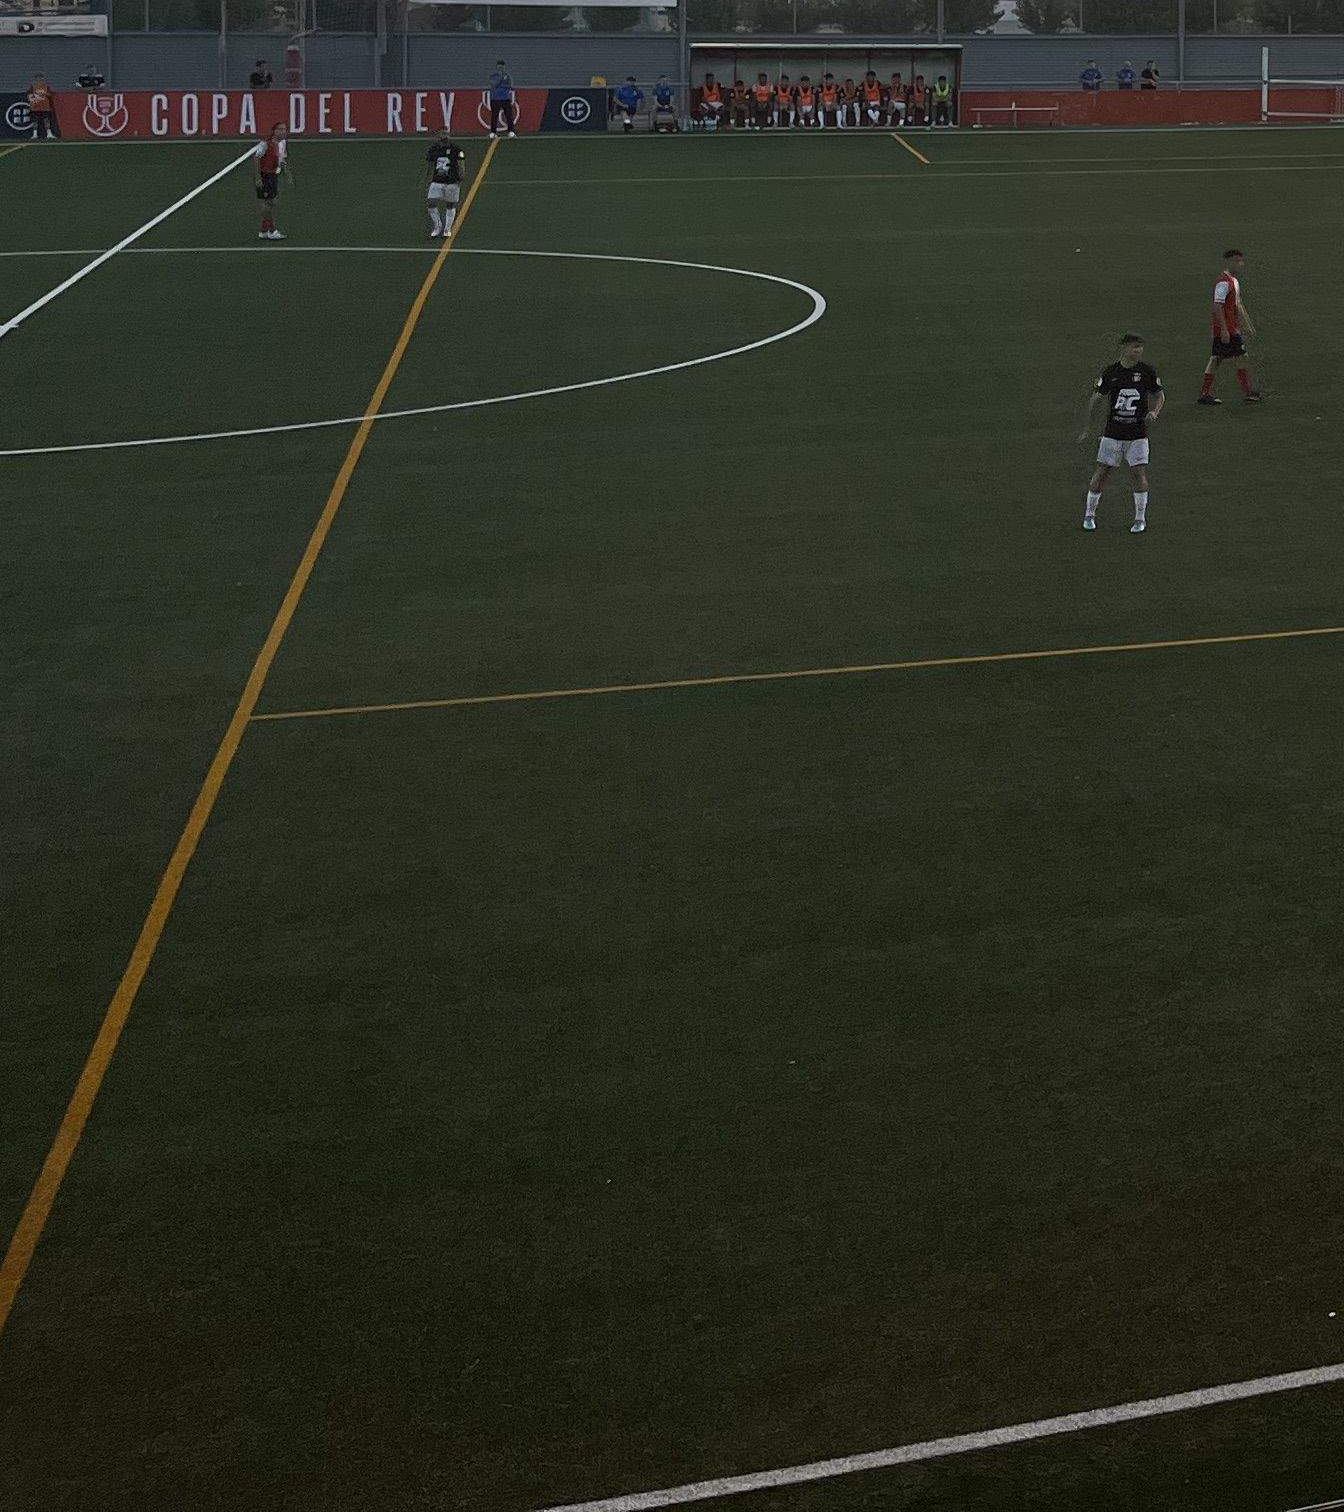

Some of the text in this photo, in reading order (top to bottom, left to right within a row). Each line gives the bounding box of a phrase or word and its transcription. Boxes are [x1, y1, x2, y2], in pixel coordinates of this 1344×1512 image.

[152, 92, 455, 136] COPA DEL REY
